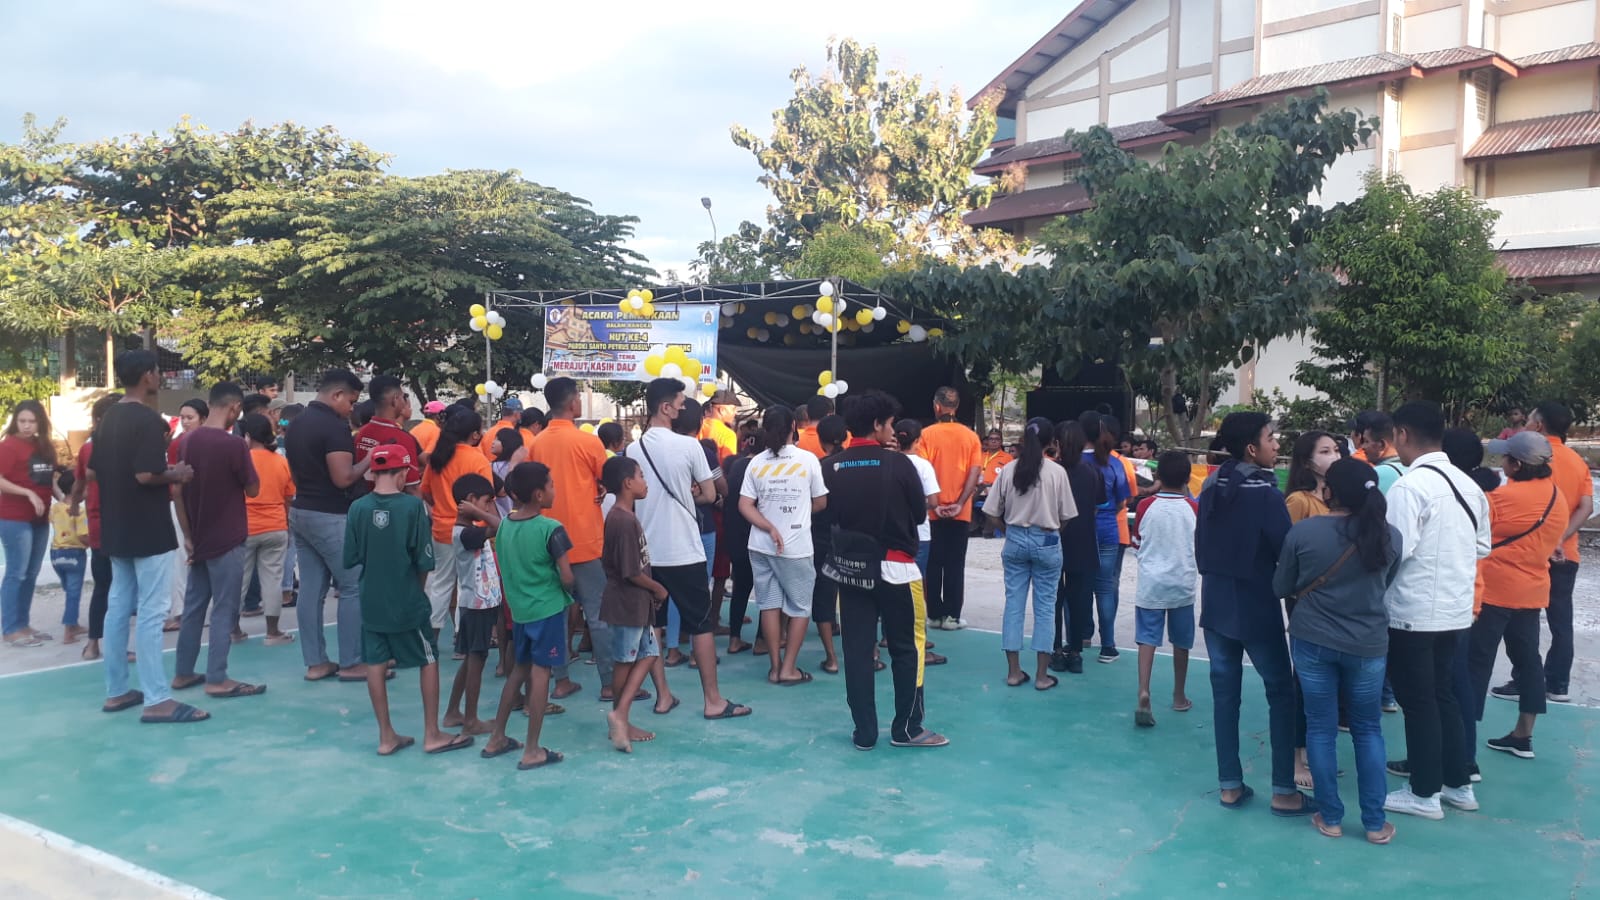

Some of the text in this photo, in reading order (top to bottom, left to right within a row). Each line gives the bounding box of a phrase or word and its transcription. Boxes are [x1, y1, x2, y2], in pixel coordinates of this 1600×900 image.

[582, 311, 614, 320] ACARA
[609, 332, 649, 342] HUT KE-4
[588, 342, 607, 350] SANTO
[590, 362, 615, 371] KASIH
